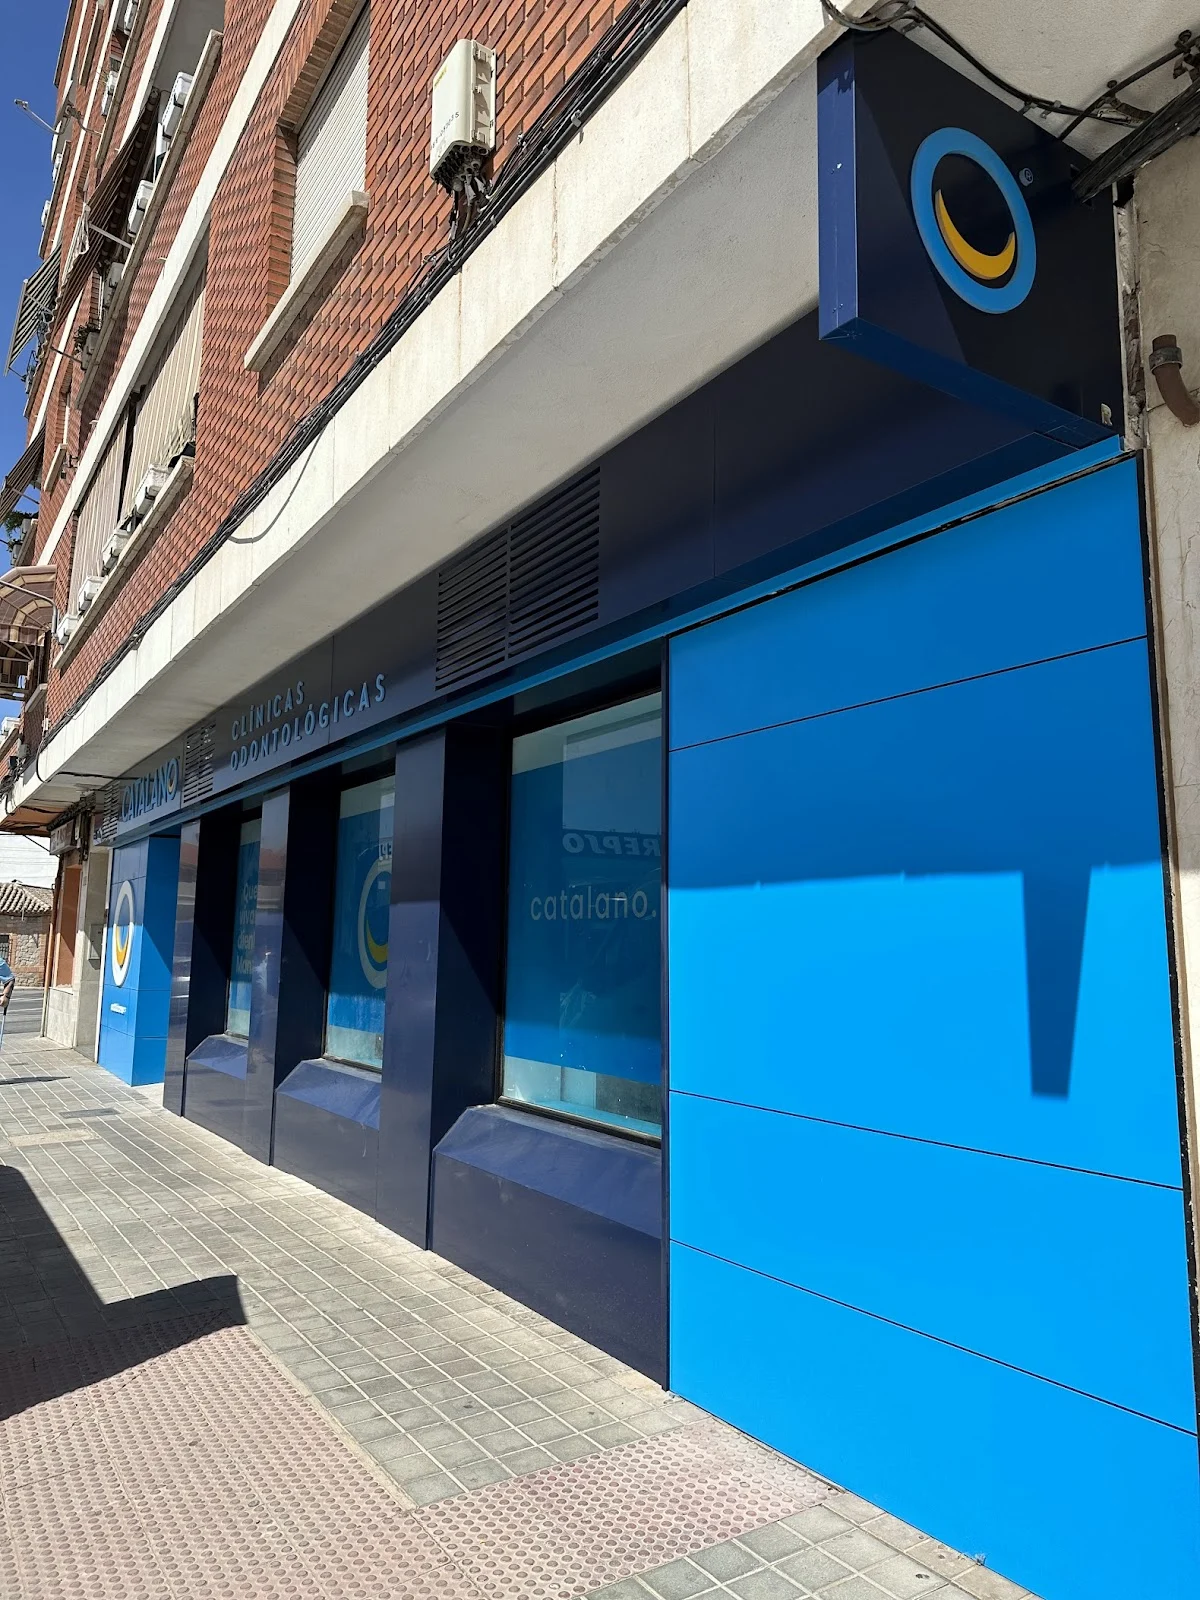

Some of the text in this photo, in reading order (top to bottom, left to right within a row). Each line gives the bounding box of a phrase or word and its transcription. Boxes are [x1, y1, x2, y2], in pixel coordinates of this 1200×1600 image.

[230, 673, 387, 771] ODONTOLÓGICAS
[231, 680, 306, 741] CLÍNICAS
[122, 757, 179, 823] CATALANO
